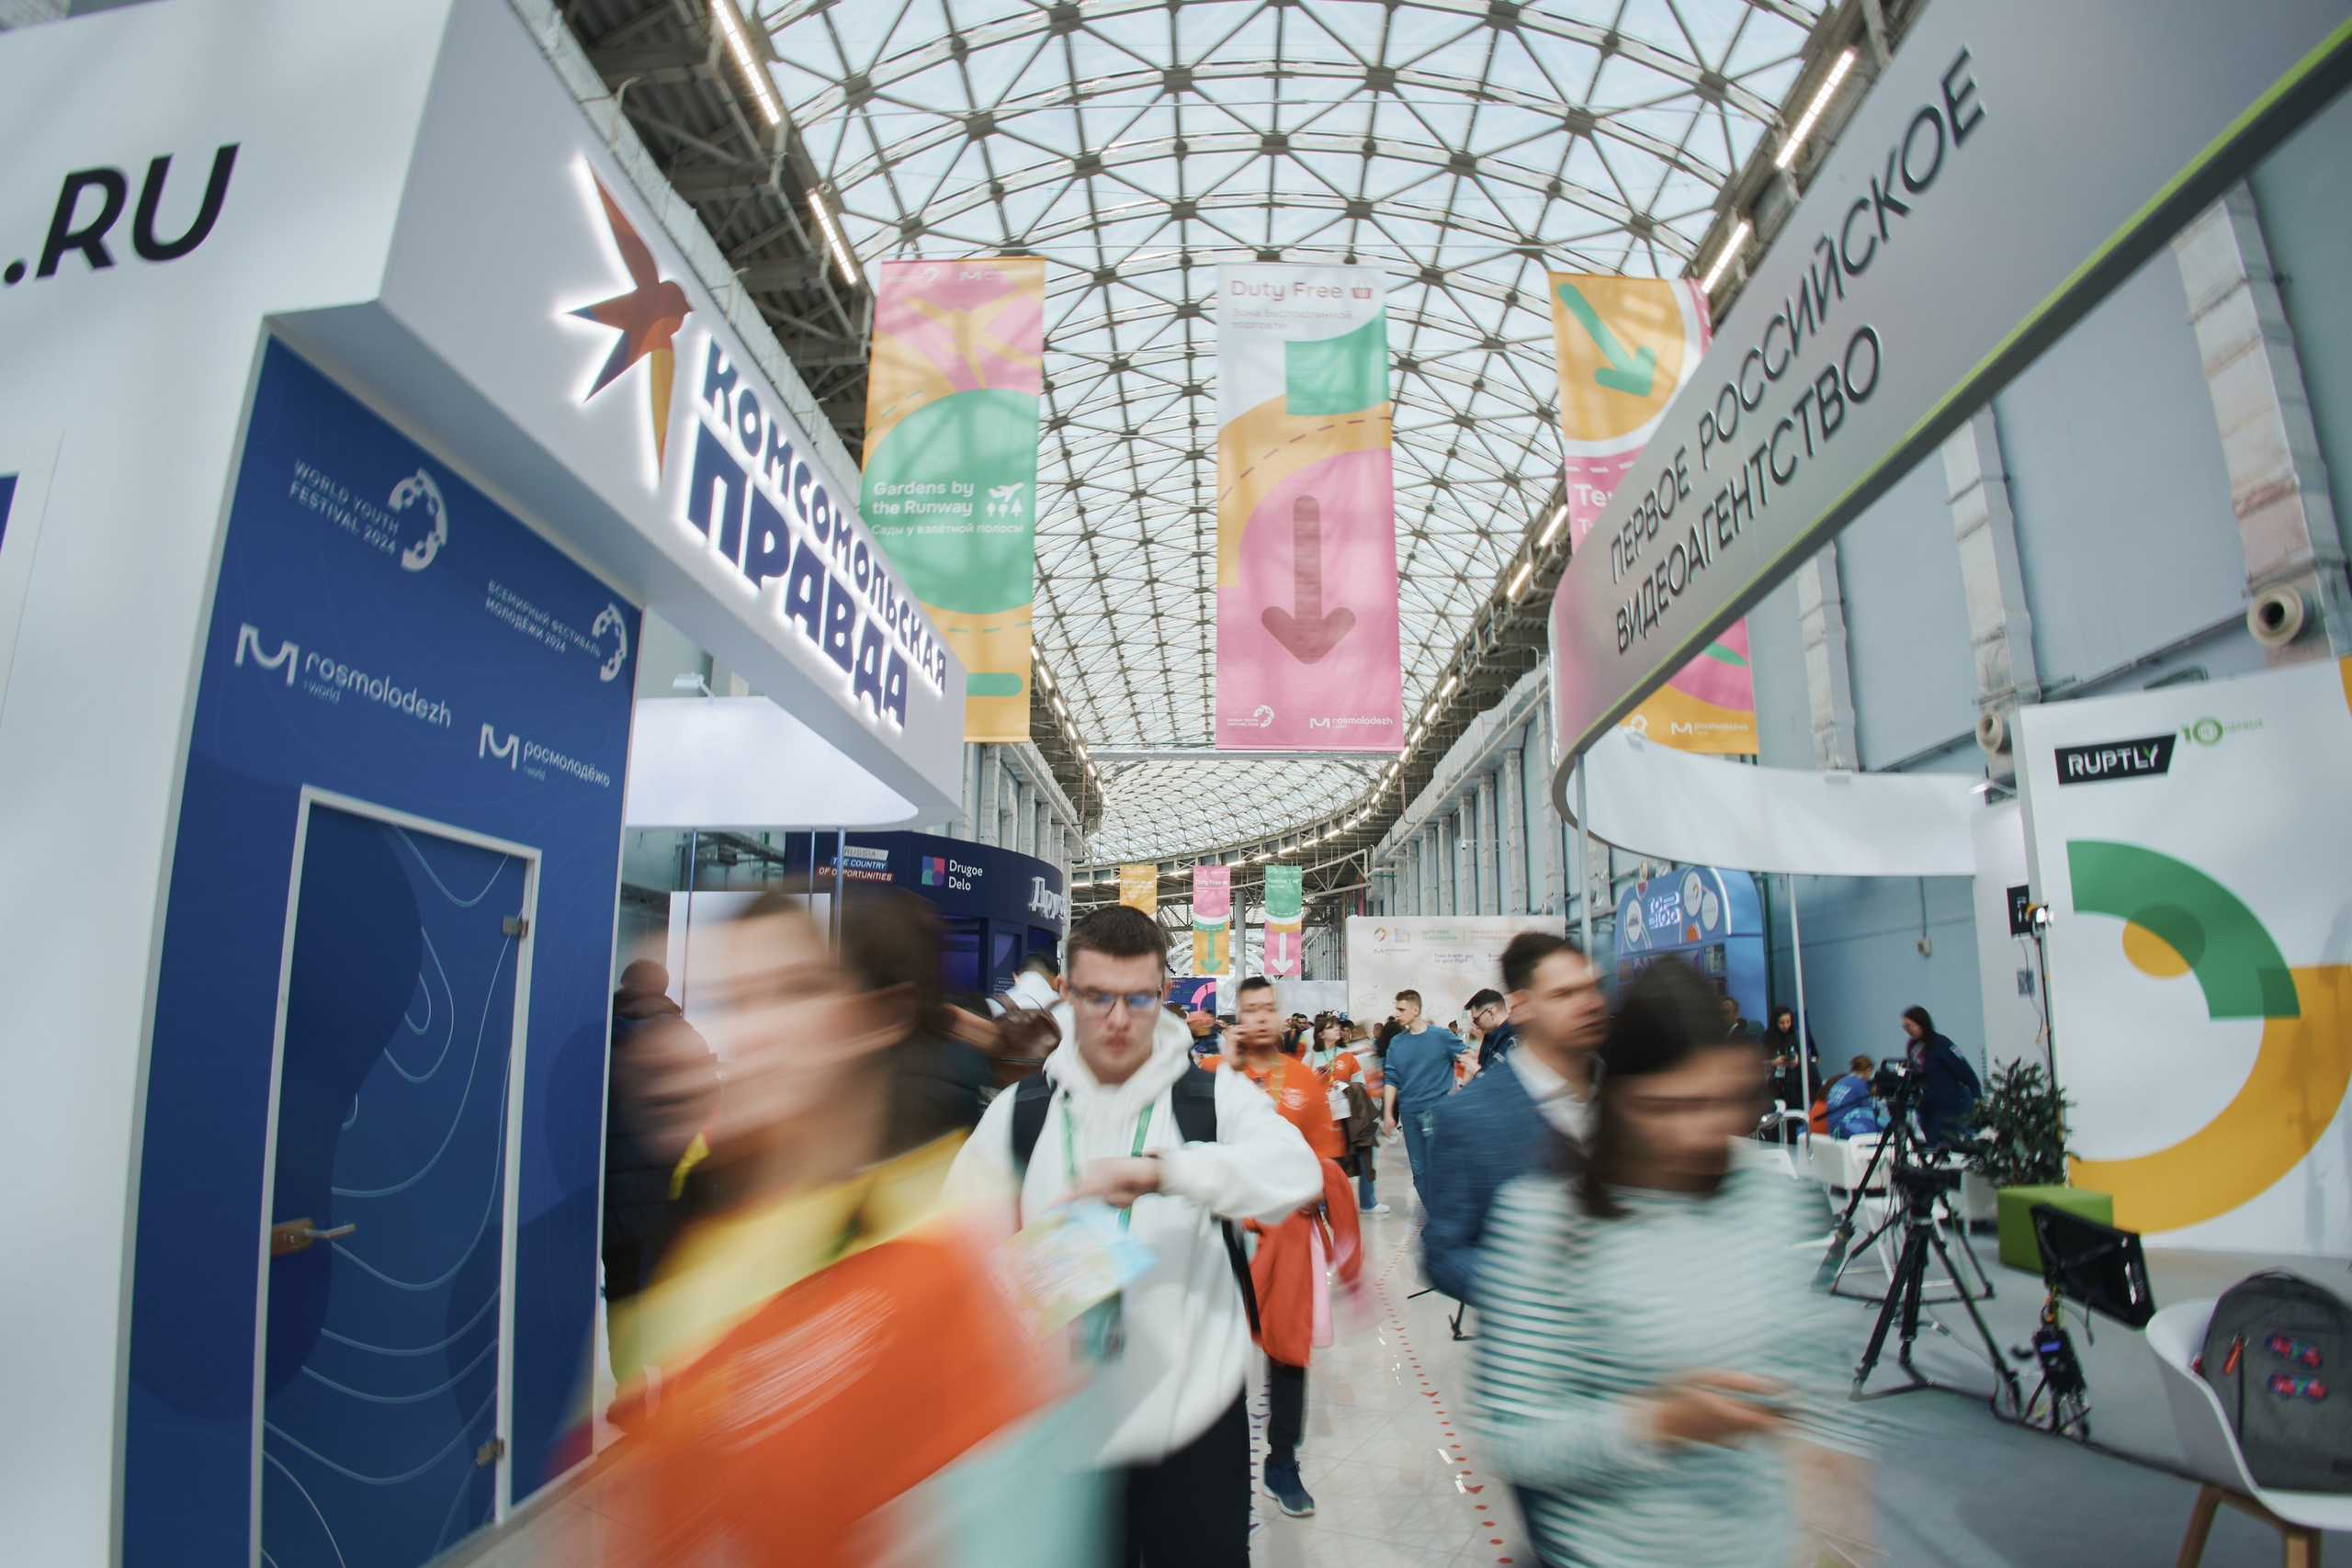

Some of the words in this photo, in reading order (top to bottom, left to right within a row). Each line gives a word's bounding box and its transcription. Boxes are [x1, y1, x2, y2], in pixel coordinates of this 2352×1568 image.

[1231, 280, 1285, 301] Duty
[1294, 282, 1343, 299] Free
[1611, 445, 1692, 584] ПЕРВОЕ
[1698, 41, 1987, 471] РОССИЙСКОЕ
[294, 458, 350, 505] WORLD
[352, 495, 400, 536] YOUTH
[873, 479, 947, 497] Gardens
[951, 480, 975, 498] by
[1616, 323, 1883, 655] ВИДЕОАГЕНТСТВО
[288, 479, 360, 536] FESTIVAL
[362, 524, 397, 556] 2024
[701, 333, 947, 695] КОМСОМОЛЬСКАЯ
[873, 501, 900, 515] the
[904, 500, 974, 517] Runway
[873, 524, 904, 536] Сады
[906, 526, 914, 537] у
[916, 522, 974, 535] взлётной
[976, 524, 1023, 534] полосы
[686, 419, 909, 730] ПРАВДА
[485, 596, 545, 641] МОЛОДЁЖИ
[487, 579, 550, 628] ВСЕМИРНЫЙ
[551, 618, 602, 660] ФЕСТИВАЛЬ
[304, 651, 452, 729] rosmolodezh
[1331, 716, 1393, 725] rosmolodezh
[2067, 743, 2159, 777] RUPTLY
[832, 857, 850, 866] TE
[850, 859, 887, 871] COUNTRY
[844, 847, 876, 857] RUSSIA
[819, 866, 831, 874] OF
[831, 869, 893, 882] OPORTUNITIES
[949, 859, 983, 877] Drugoe
[948, 875, 971, 891] Delo
